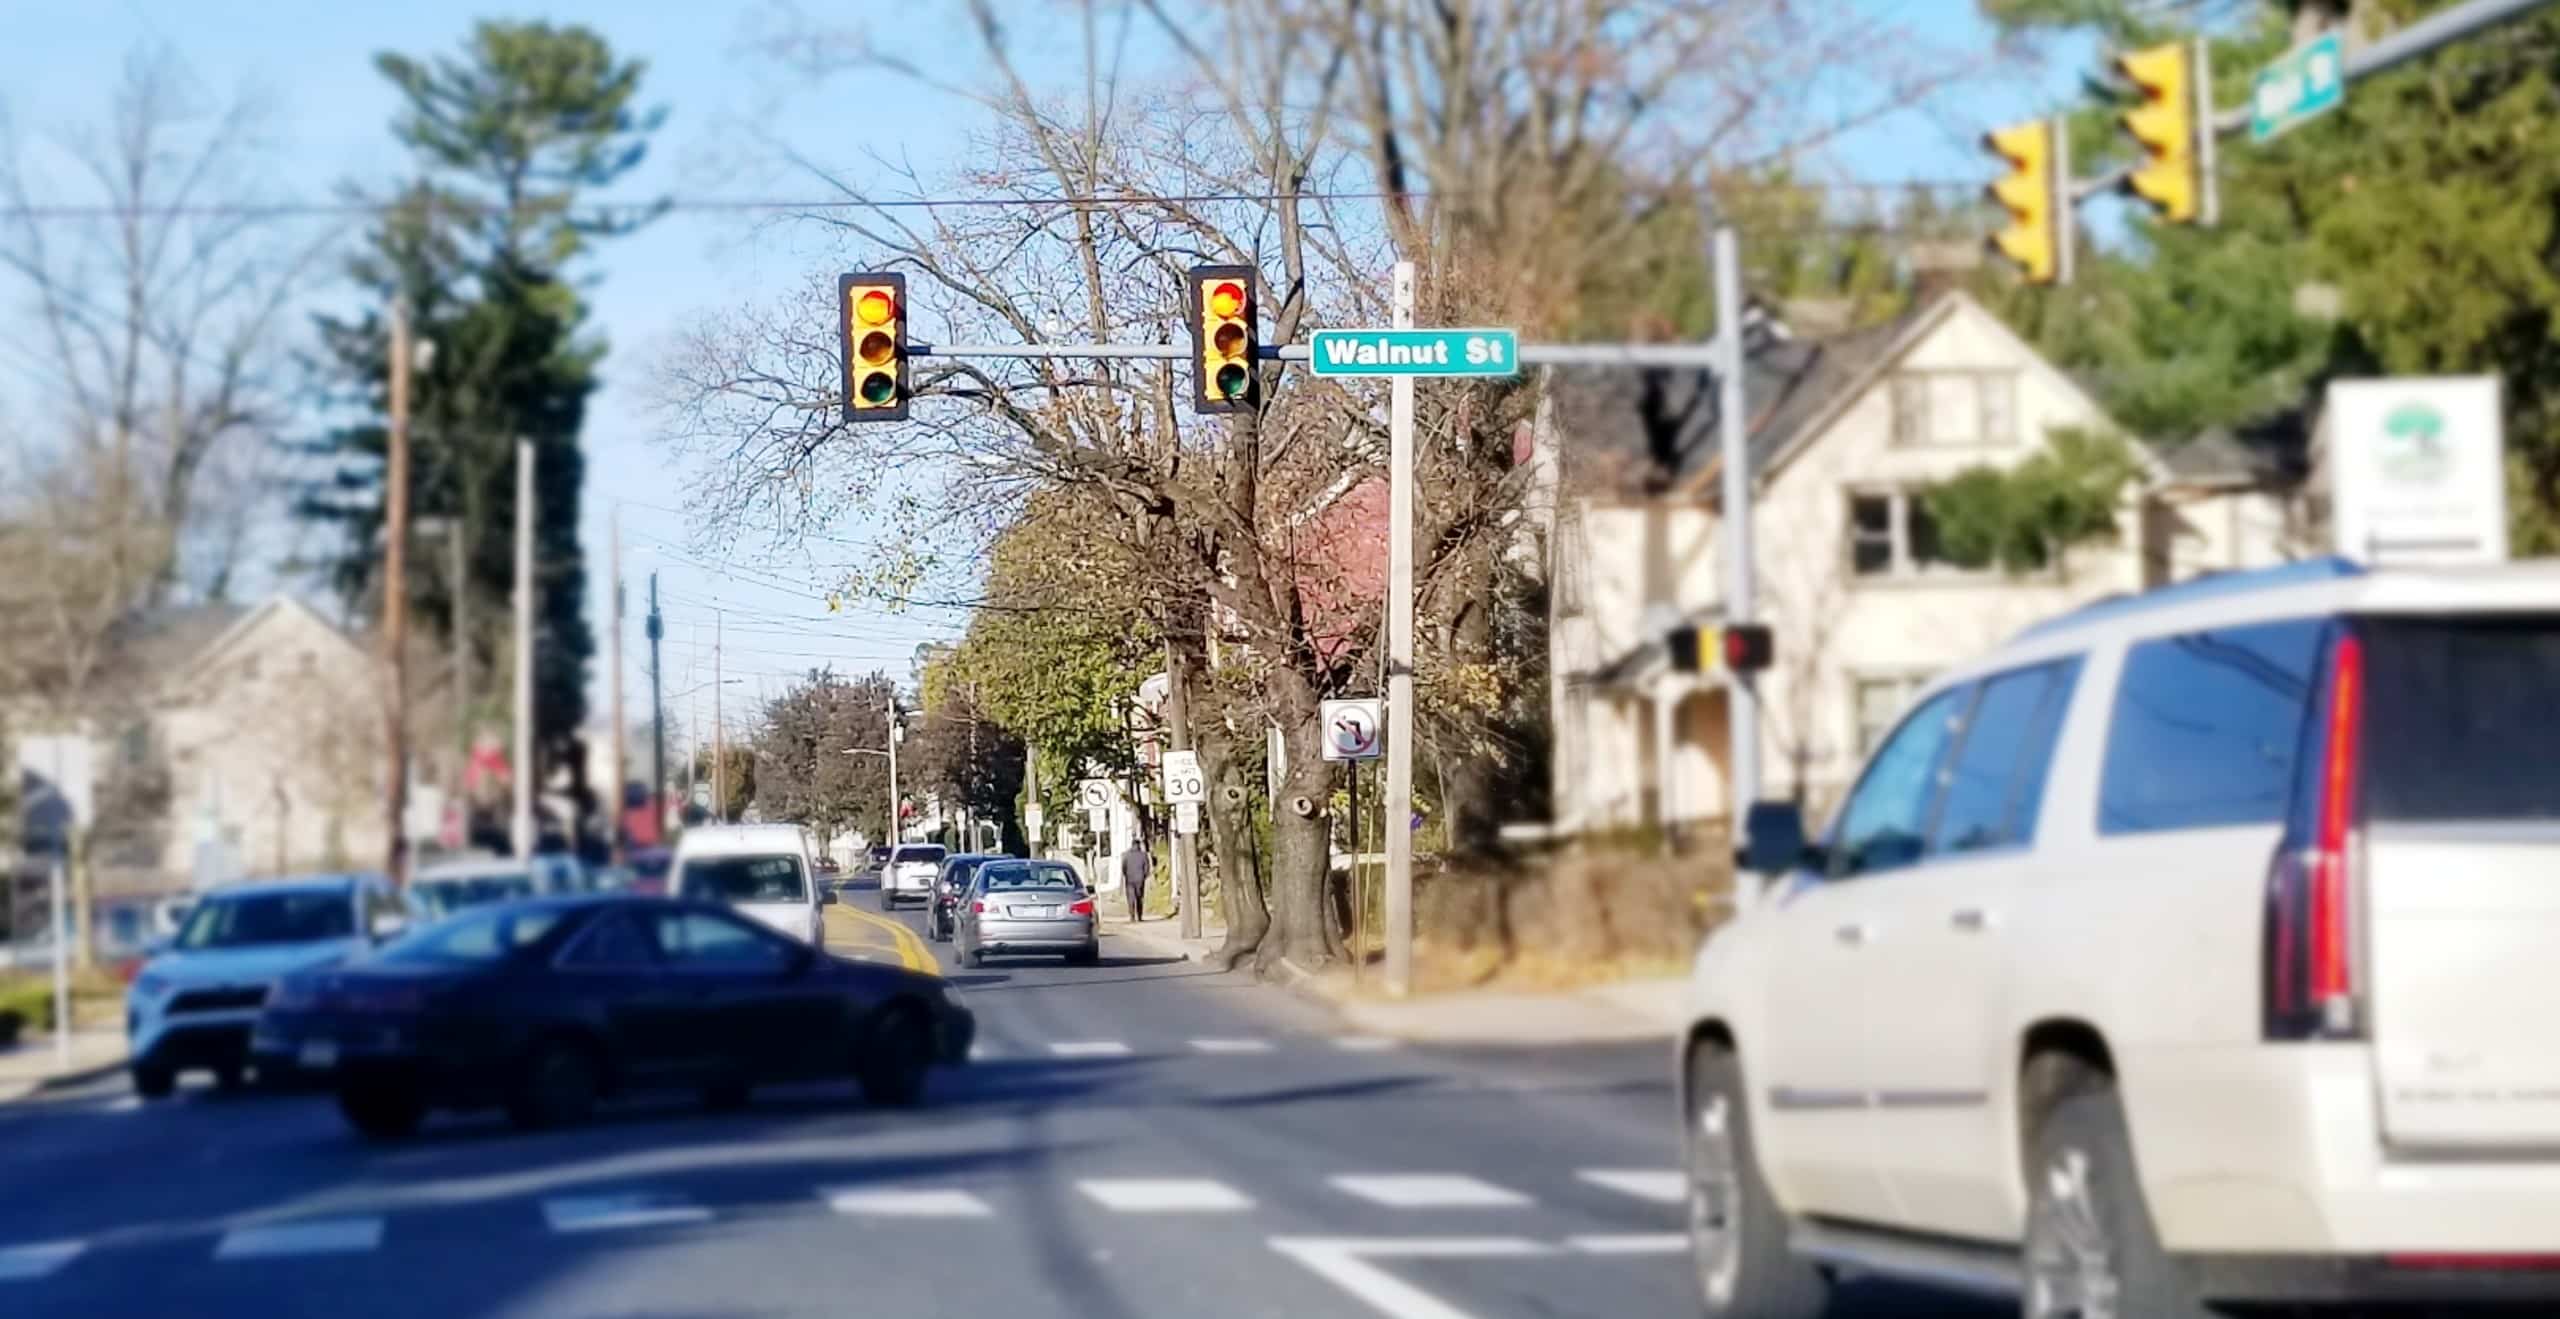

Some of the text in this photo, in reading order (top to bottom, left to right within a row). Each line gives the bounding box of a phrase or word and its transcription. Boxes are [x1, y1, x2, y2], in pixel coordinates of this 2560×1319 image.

[1324, 337, 1504, 365] Walnut St
[1171, 778, 1201, 795] 30
